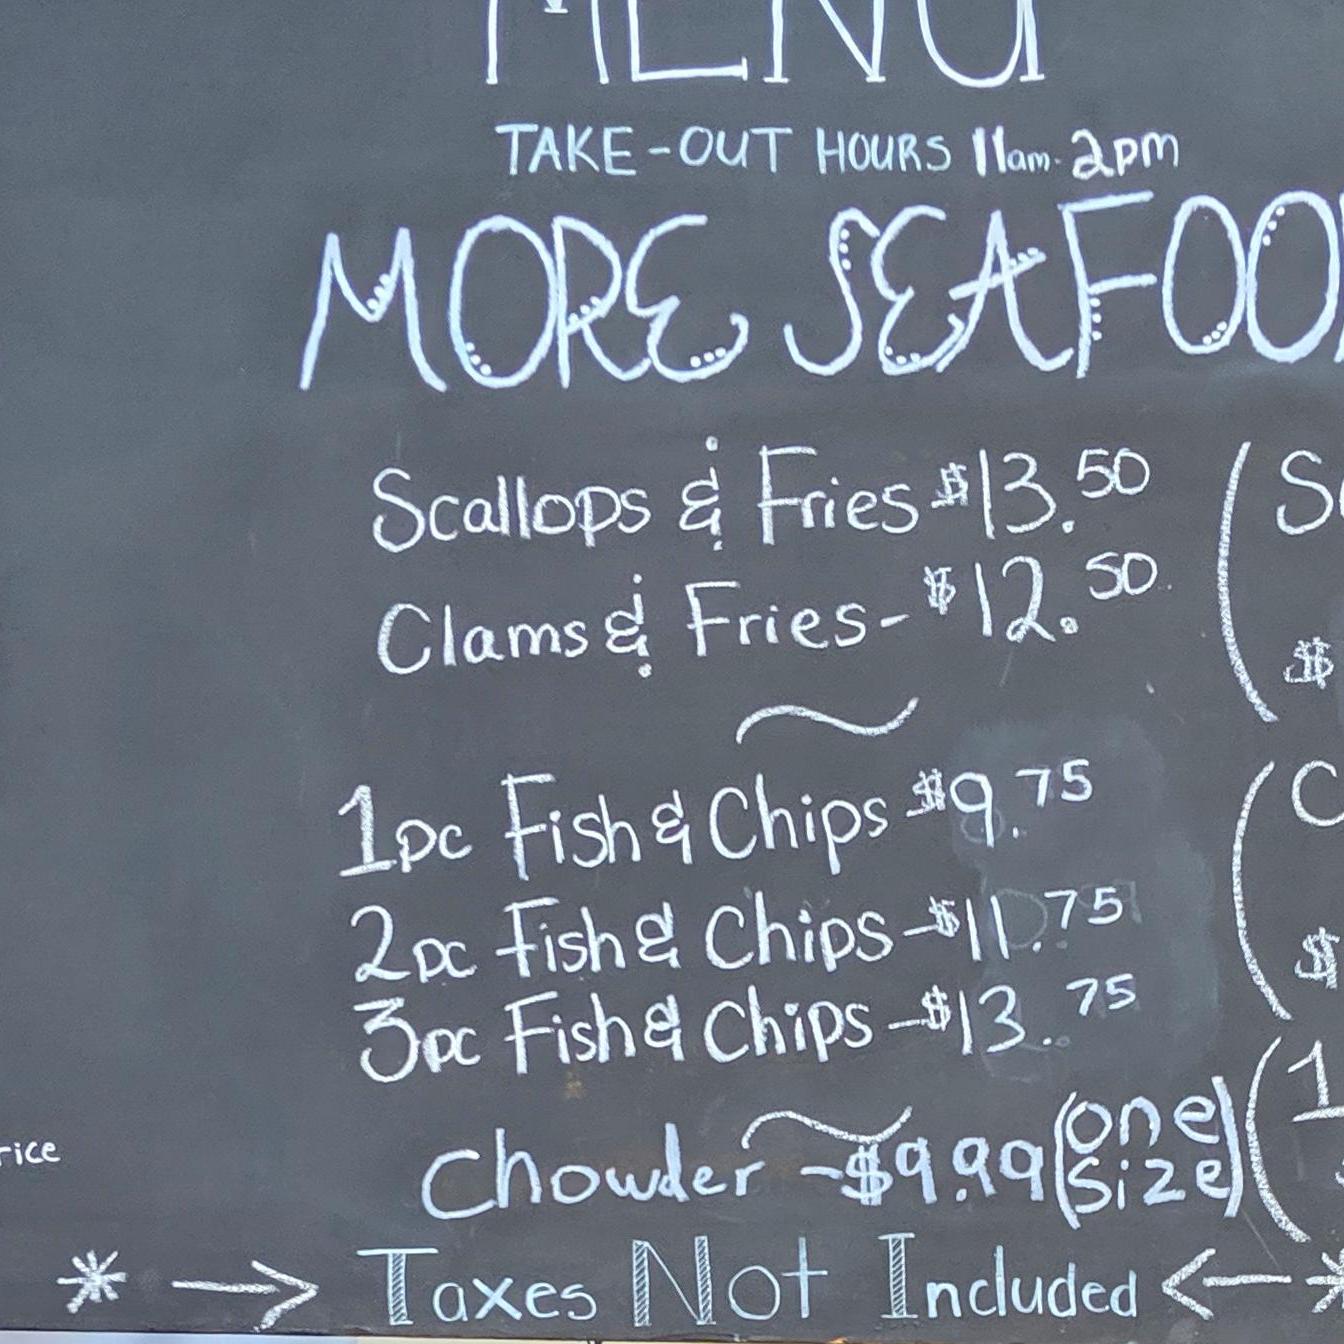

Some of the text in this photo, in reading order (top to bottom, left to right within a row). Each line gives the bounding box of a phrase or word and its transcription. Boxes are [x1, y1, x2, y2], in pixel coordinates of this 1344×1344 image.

[495, 123, 792, 175] TAKE-OUT
[816, 128, 951, 174] HOURS
[300, 214, 749, 392] MORE
[373, 468, 651, 553] Scallops
[377, 604, 588, 674] Clams
[338, 785, 472, 876] 1pc
[501, 773, 641, 881] Fish
[709, 773, 888, 875] Chips
[351, 905, 477, 983] 2pc
[496, 897, 625, 977] Fish
[705, 891, 893, 972] Chips
[354, 997, 480, 1083] 3pc
[504, 991, 636, 1074] Fish
[704, 985, 872, 1062] Chips
[357, 1233, 1136, 1327] Taxes Not Included
